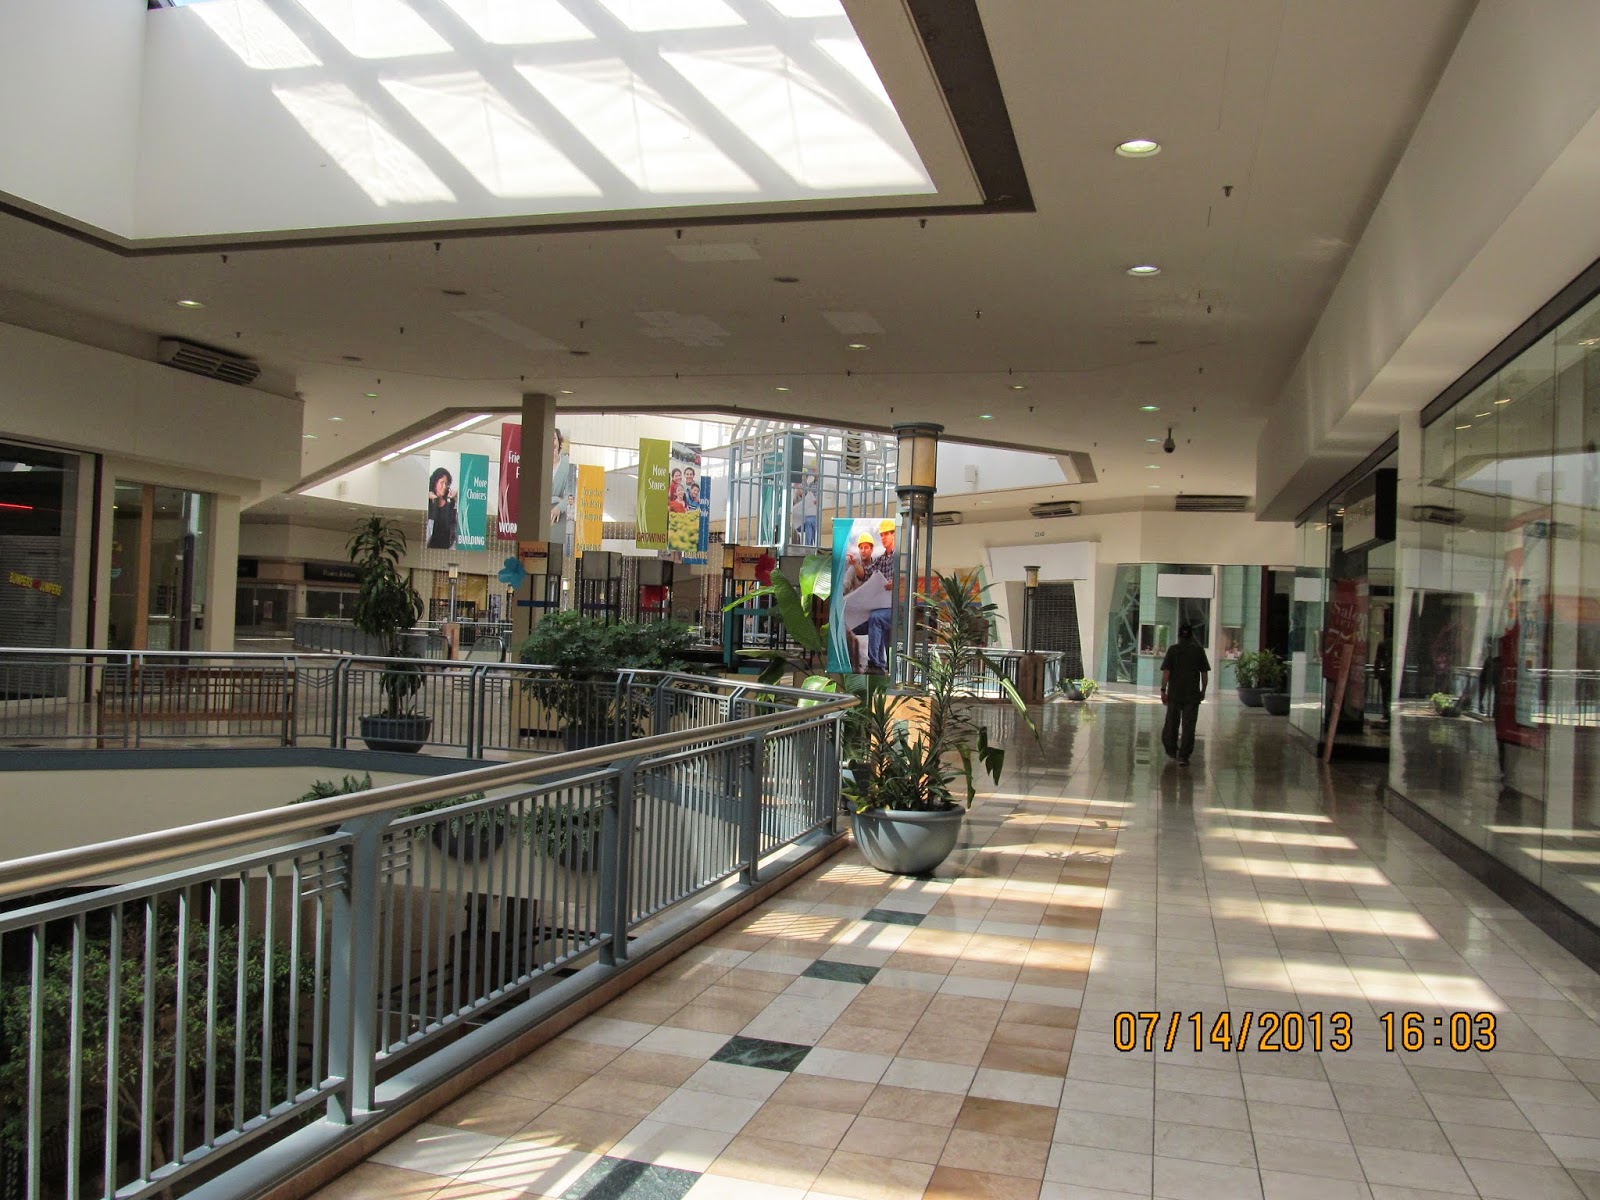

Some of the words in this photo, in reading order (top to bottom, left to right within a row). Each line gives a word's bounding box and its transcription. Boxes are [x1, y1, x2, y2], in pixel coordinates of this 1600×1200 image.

[652, 464, 667, 477] More
[473, 476, 488, 488] More
[648, 479, 667, 491] Stores
[467, 488, 487, 501] Choices
[458, 535, 485, 546] BUILDING
[636, 532, 666, 544] GROWING
